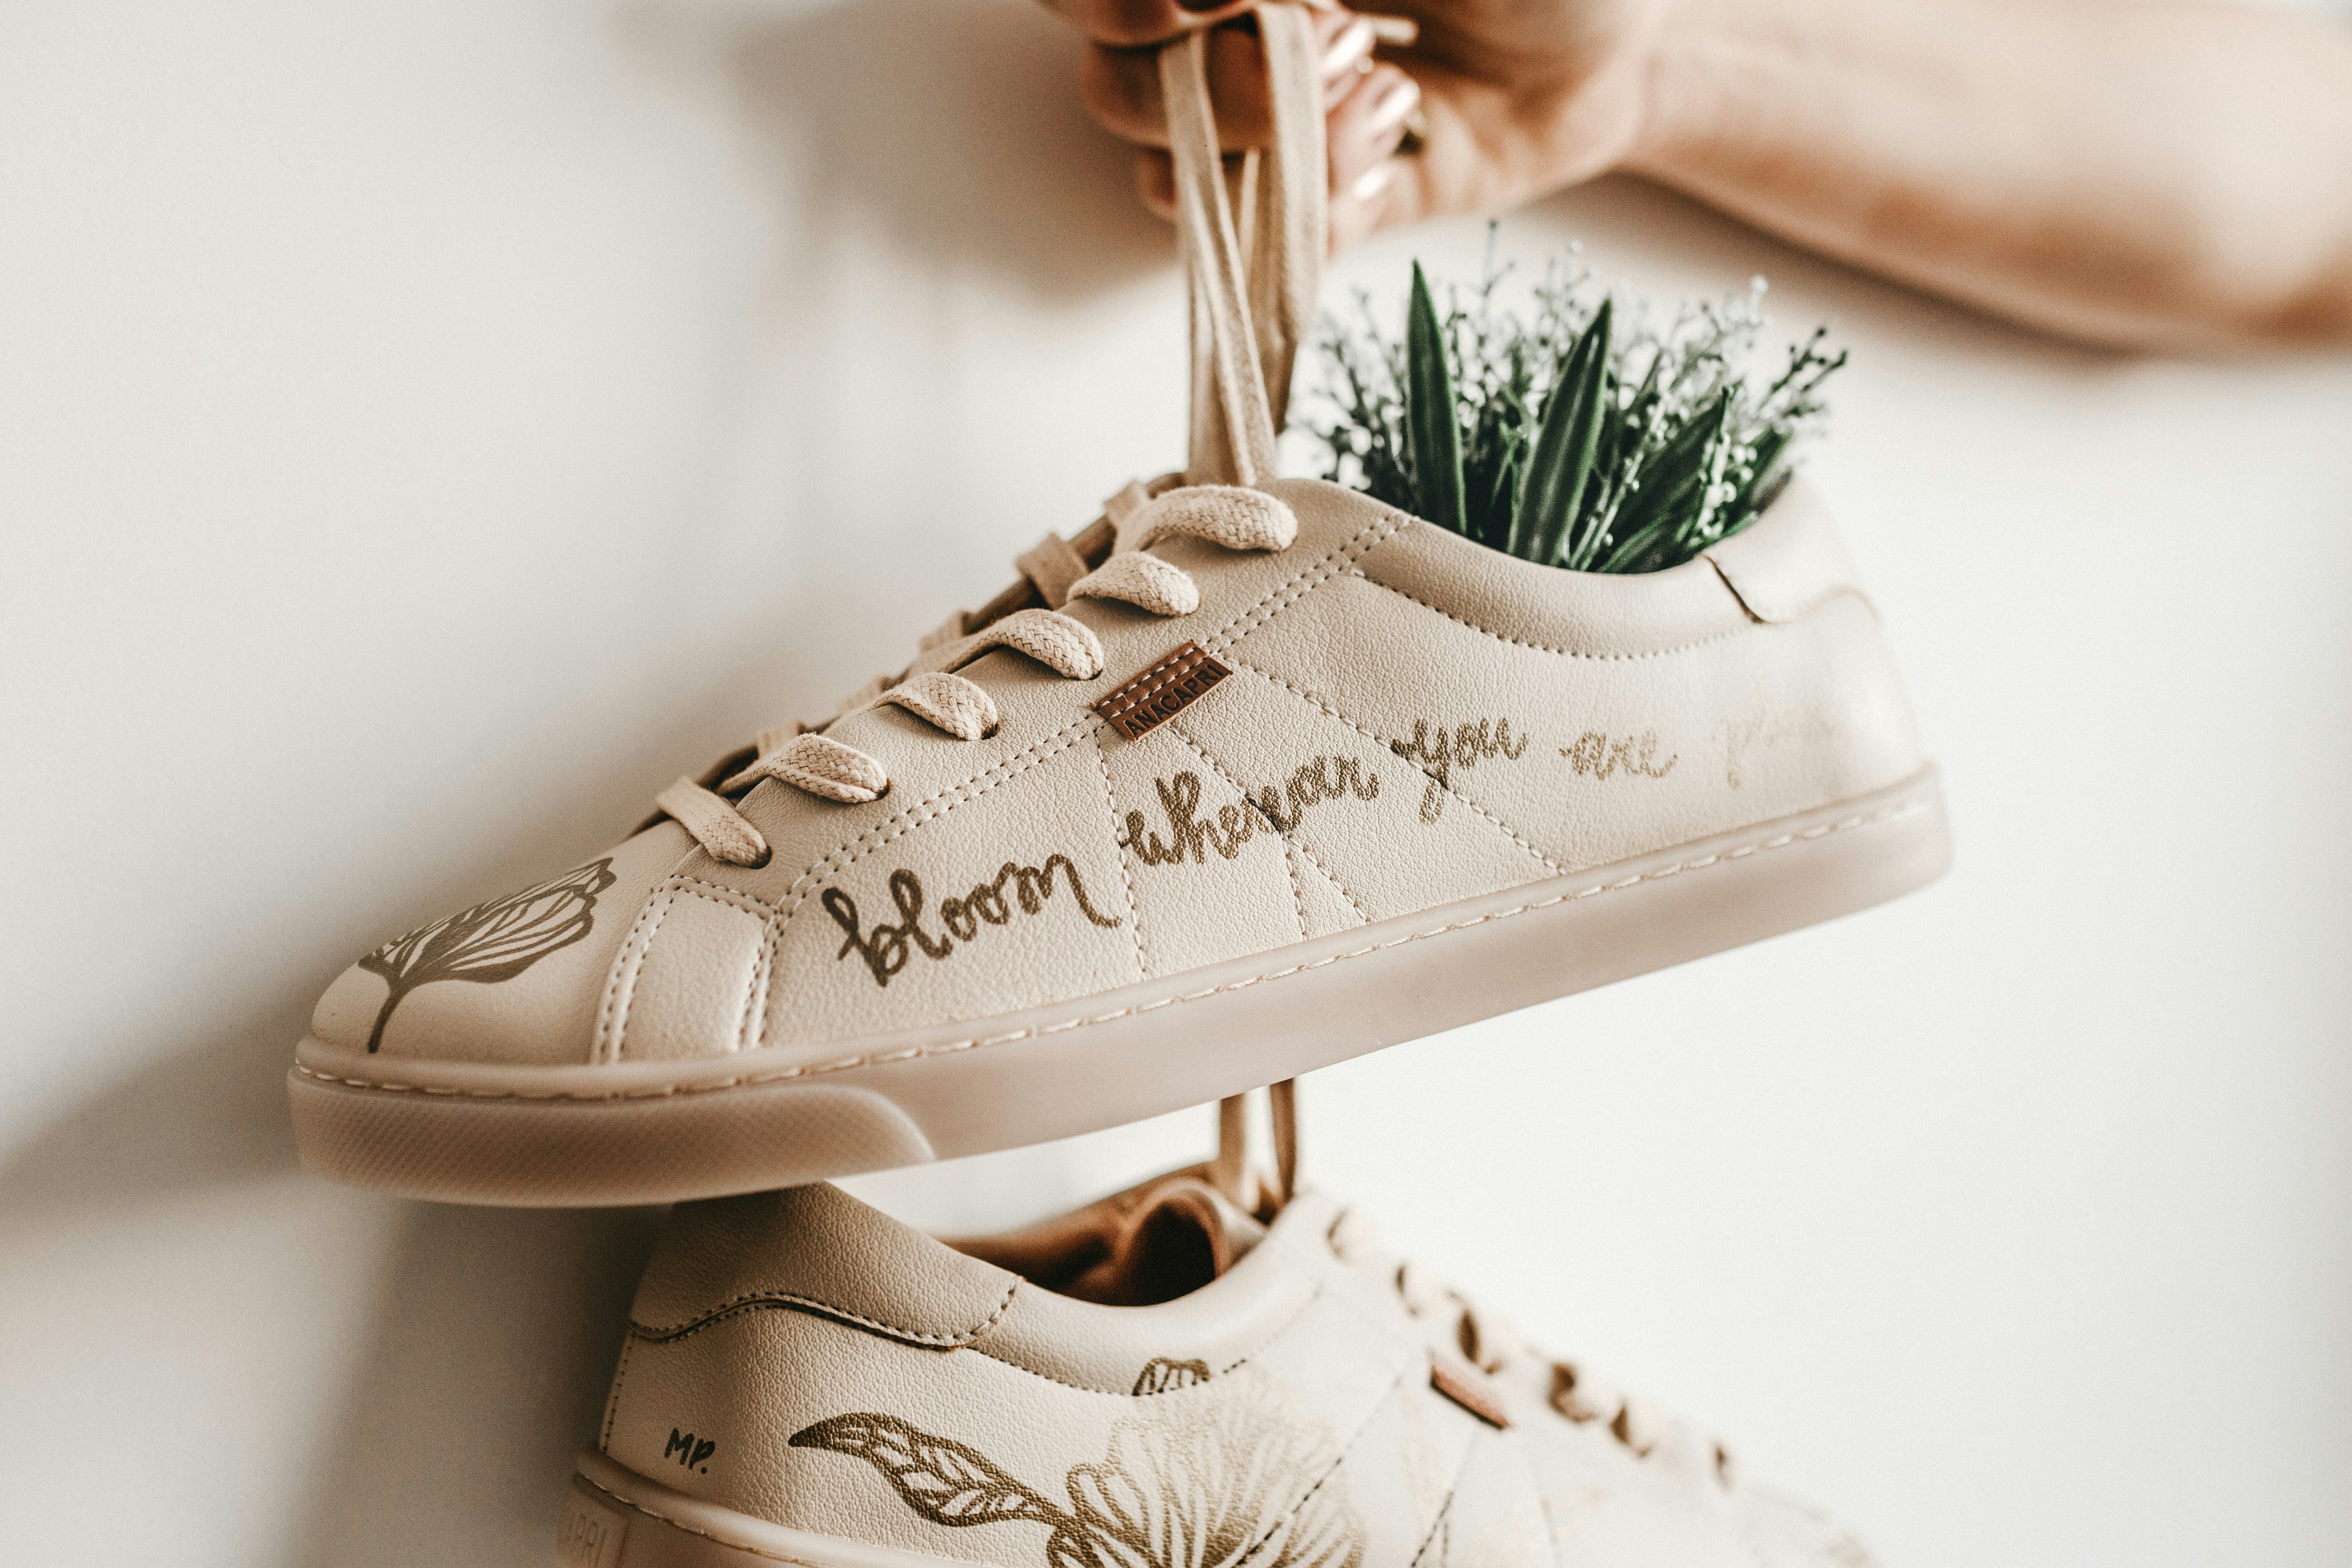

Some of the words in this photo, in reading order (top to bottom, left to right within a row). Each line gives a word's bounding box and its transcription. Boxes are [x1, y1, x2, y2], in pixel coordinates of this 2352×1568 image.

[1124, 664, 1225, 736] ANACAPRI
[821, 853, 1122, 987] bloom
[1391, 717, 1528, 825] you
[1559, 730, 1678, 780] are
